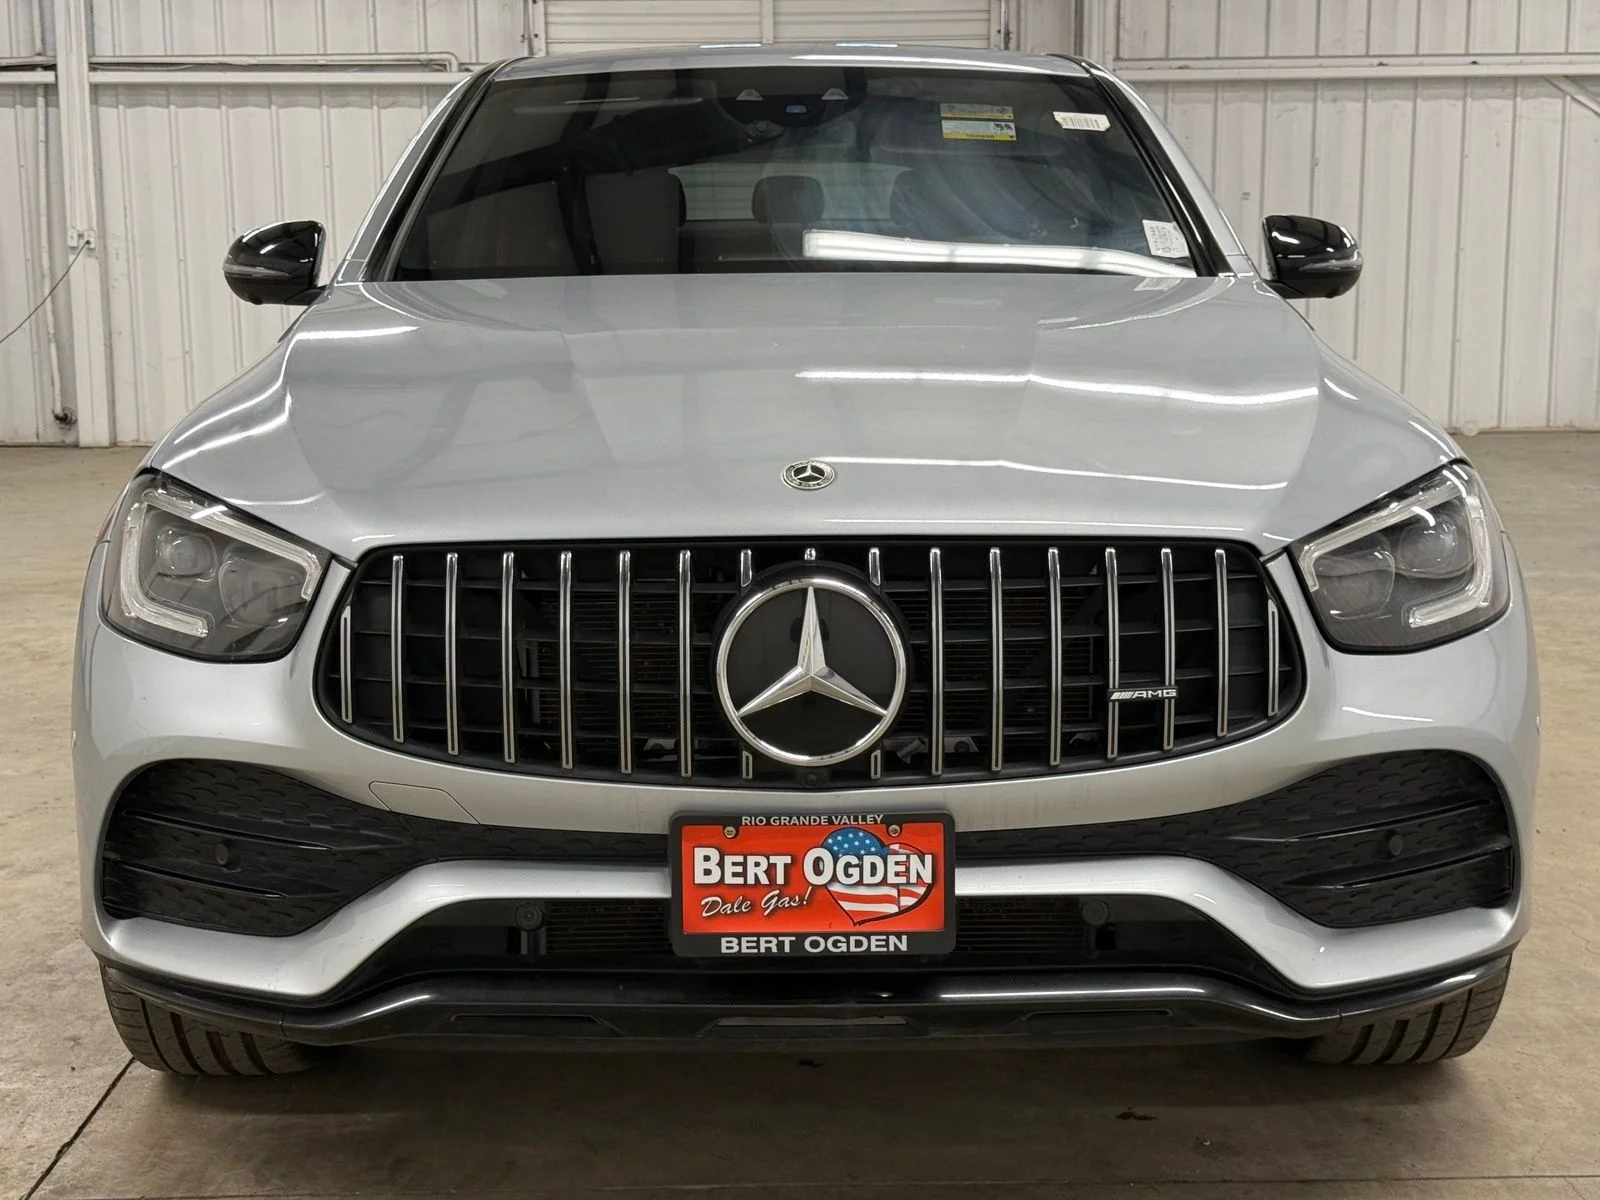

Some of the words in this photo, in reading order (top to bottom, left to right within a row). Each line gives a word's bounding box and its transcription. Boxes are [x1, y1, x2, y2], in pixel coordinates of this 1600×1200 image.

[741, 815, 767, 826] RIO
[769, 815, 829, 826] GRANDE
[831, 814, 884, 825] VALLEY
[693, 846, 792, 885] BERT
[802, 847, 933, 885] OGDEN
[700, 896, 752, 918] Dale
[760, 886, 814, 916] Gas!
[720, 936, 796, 954] BERT
[804, 935, 908, 953] OGDEN
